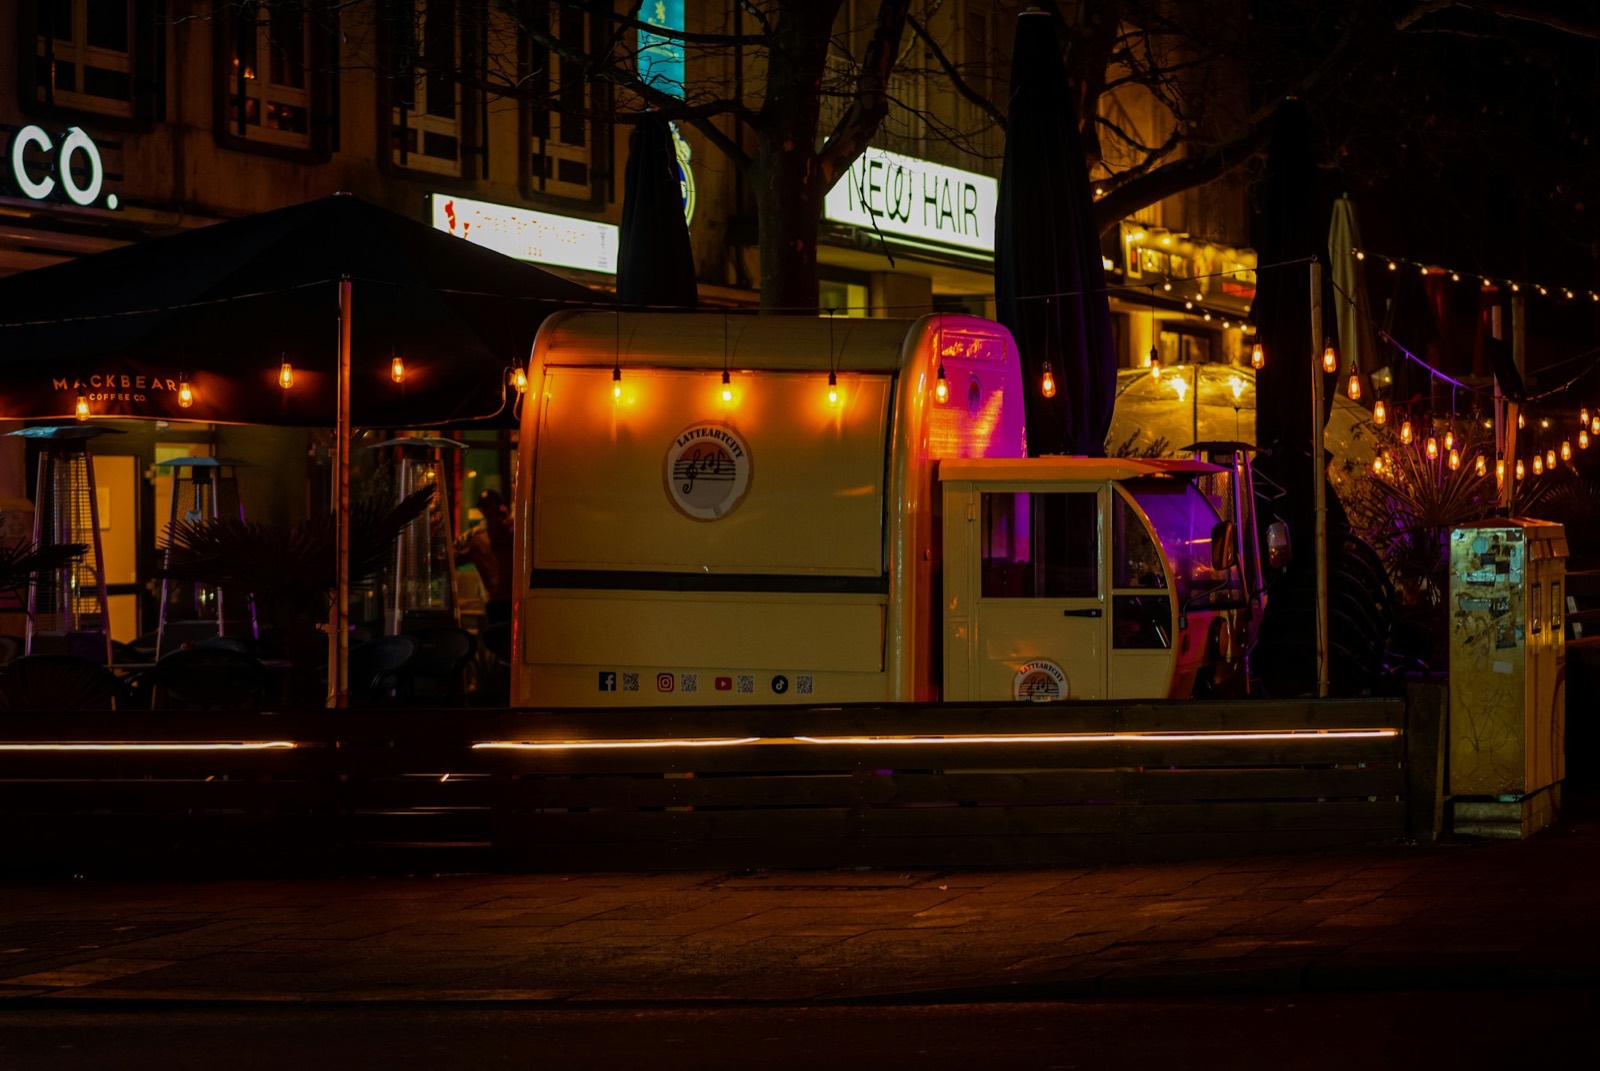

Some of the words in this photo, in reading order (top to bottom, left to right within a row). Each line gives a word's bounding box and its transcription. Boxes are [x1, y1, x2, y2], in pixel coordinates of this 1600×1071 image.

[12, 125, 118, 210] CO.
[848, 158, 912, 224] NEW
[923, 171, 979, 237] HAIR
[89, 392, 131, 401] COFFEE
[676, 428, 744, 458] LATTEARTCITY
[1019, 661, 1064, 682] LATTEARTCITY
